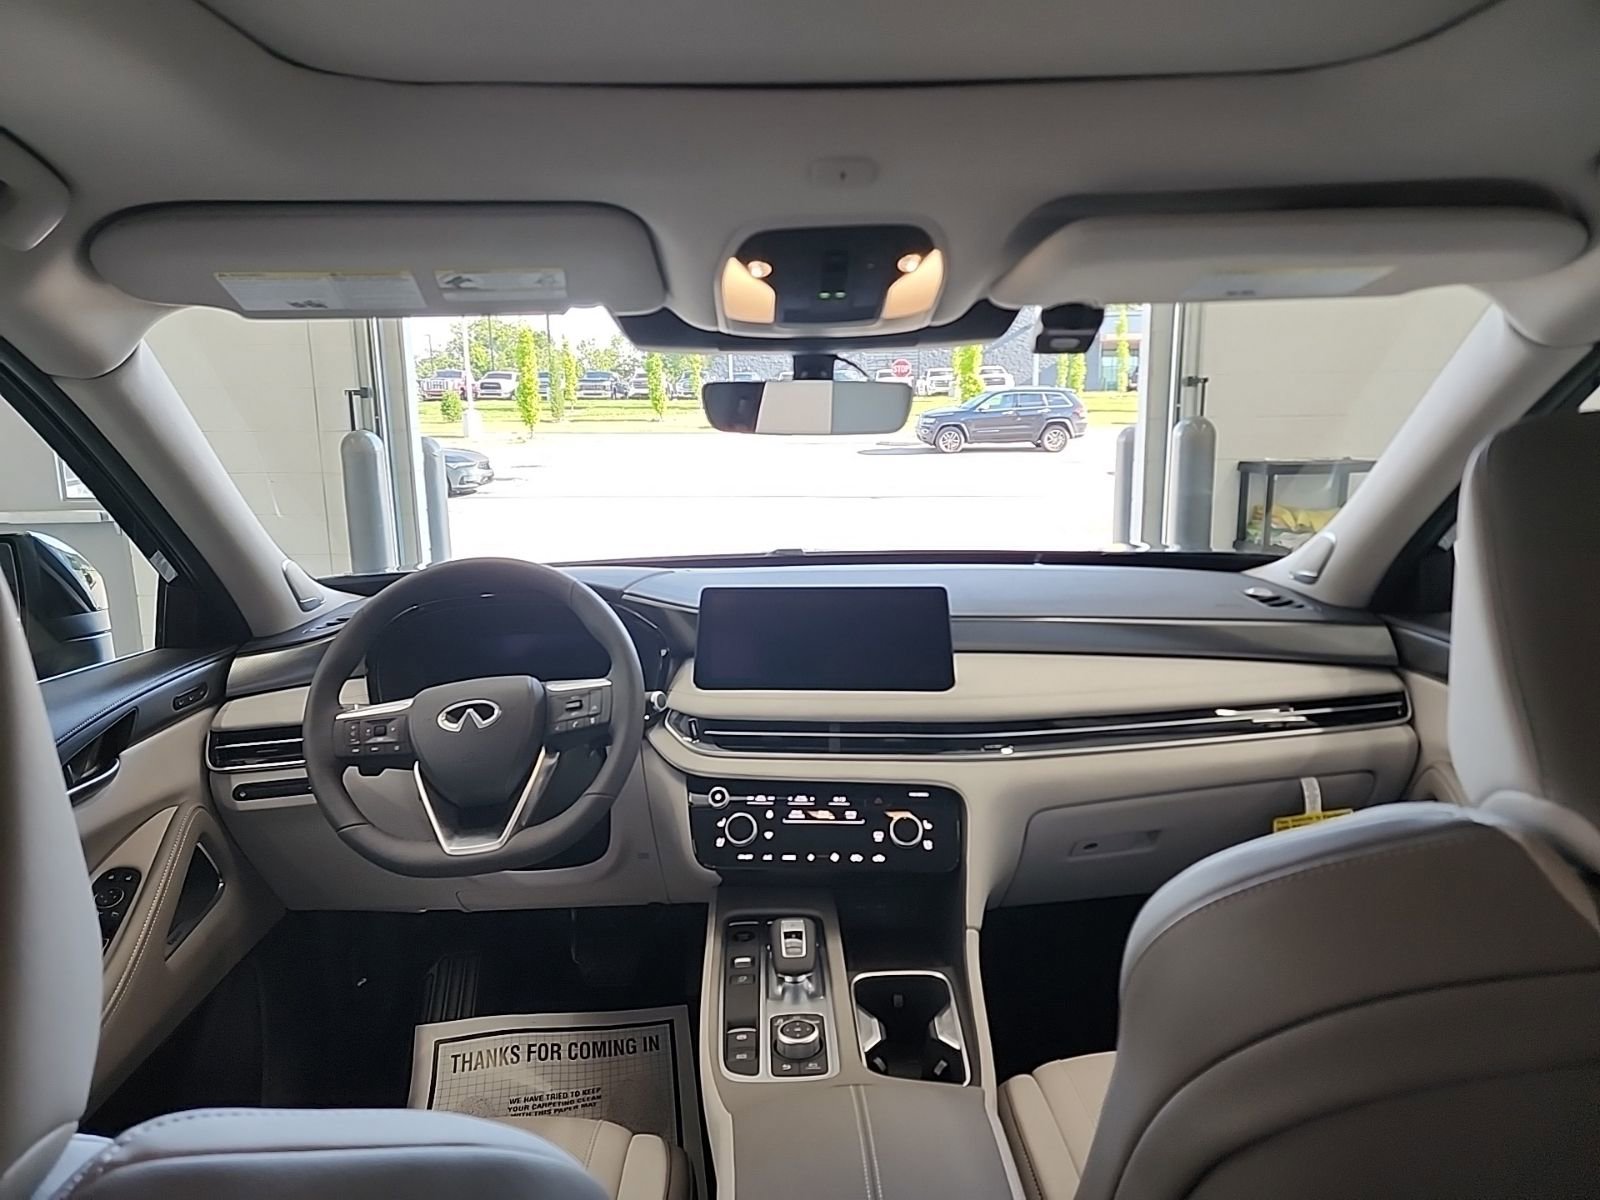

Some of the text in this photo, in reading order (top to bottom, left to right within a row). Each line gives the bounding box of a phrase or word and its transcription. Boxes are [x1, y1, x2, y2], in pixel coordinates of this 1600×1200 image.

[450, 1034, 660, 1074] THANKS FOR COMING IN
[507, 1104, 530, 1112] YOUR
[577, 1095, 602, 1103] CLEAN
[509, 1087, 601, 1105] WE HAVE TRIED TO KEEP
[534, 1109, 552, 1117] THIS
[553, 1104, 579, 1114] PAPER
[581, 1101, 597, 1109] MAT
